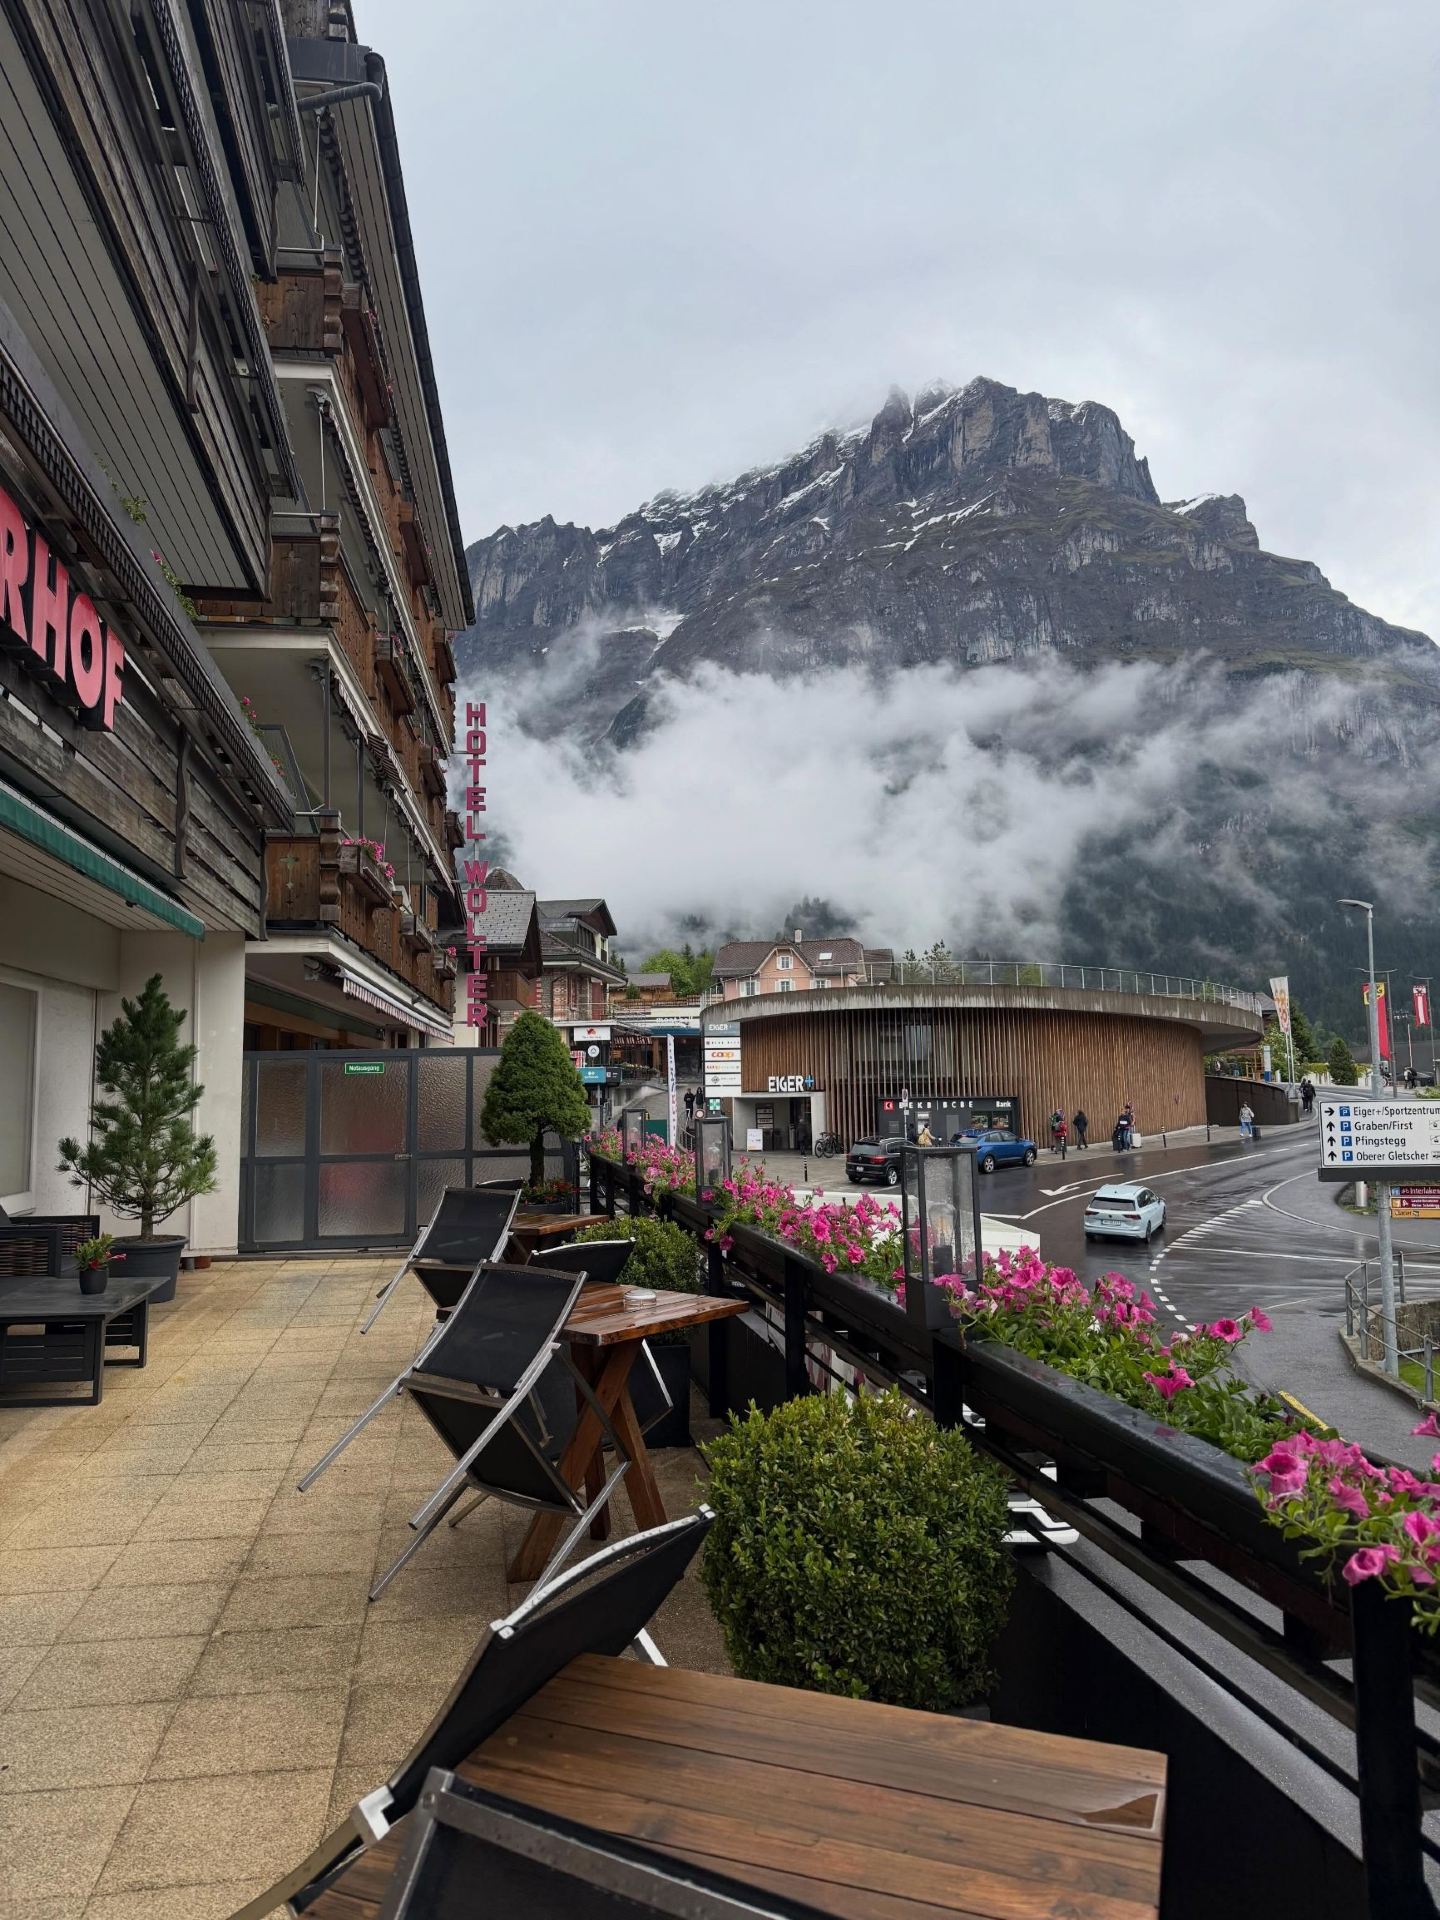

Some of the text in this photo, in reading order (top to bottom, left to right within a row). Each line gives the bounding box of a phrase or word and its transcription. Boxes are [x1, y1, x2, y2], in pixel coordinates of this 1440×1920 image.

[0, 486, 125, 732] RHOF
[466, 702, 487, 840] HOTEL
[464, 860, 489, 1028] WOLTER
[996, 1100, 1011, 1108] Bank
[1354, 1121, 1413, 1131] Graben/First
[1355, 1136, 1406, 1147] Pfingstegg
[1356, 1151, 1385, 1160] Oberer
[1388, 1150, 1429, 1160] Gletscher
